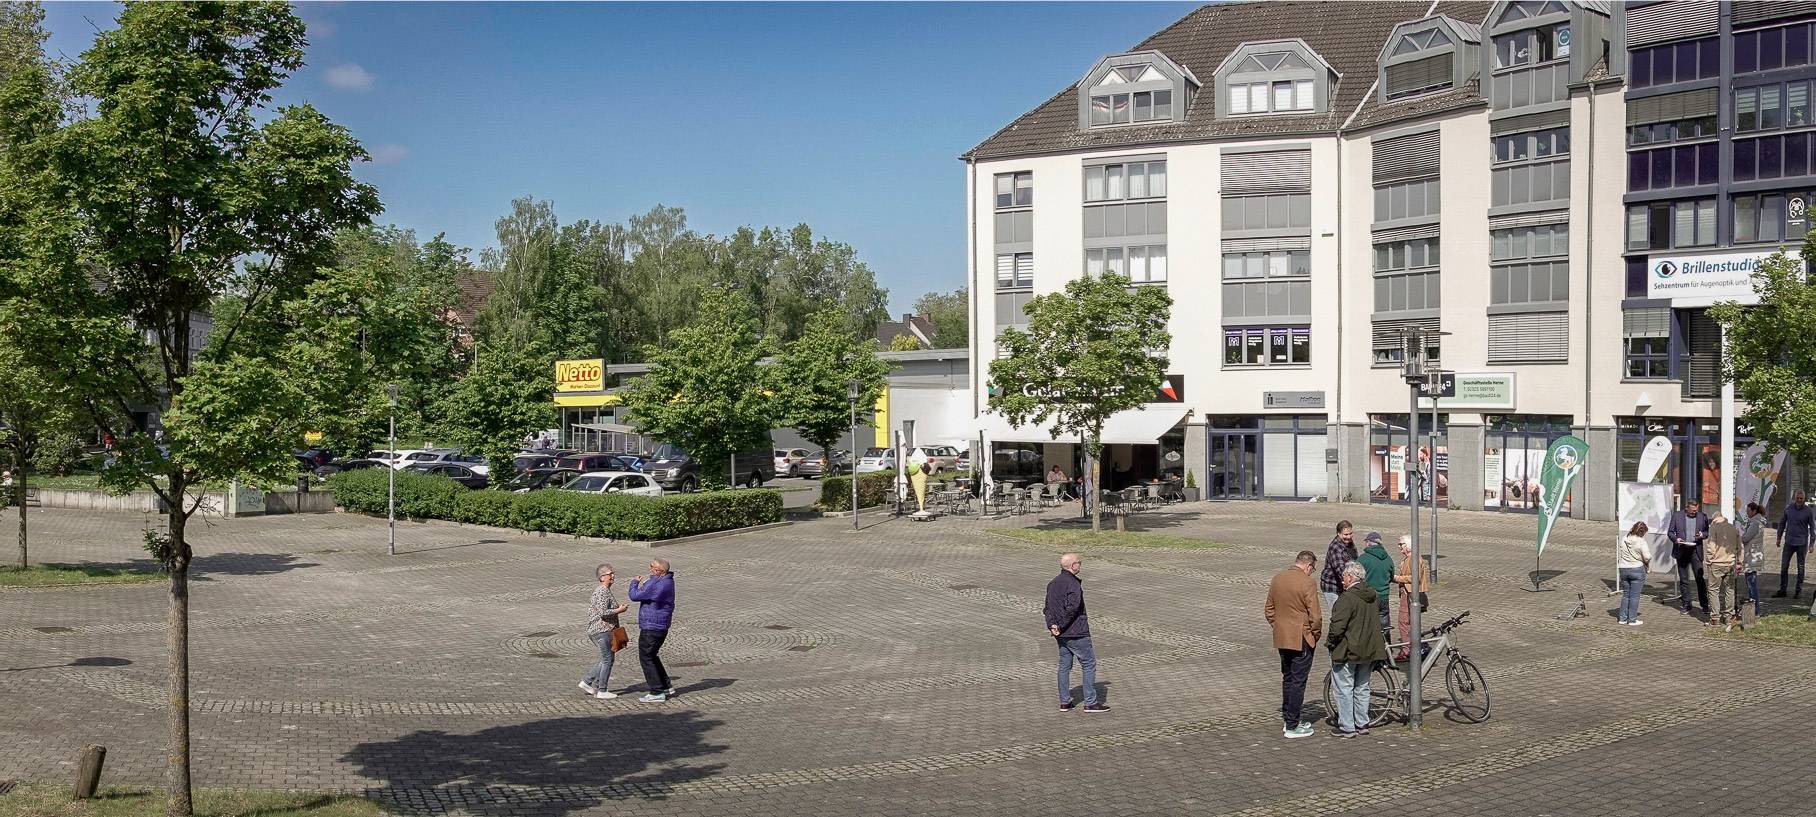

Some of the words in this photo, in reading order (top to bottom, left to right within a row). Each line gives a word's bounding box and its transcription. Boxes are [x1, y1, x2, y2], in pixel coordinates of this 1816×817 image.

[1682, 258, 1760, 274] Brillenstudio
[1654, 282, 1690, 290] Sehzentrum
[1700, 280, 1734, 289] Augenoptik
[559, 363, 601, 382] Netto
